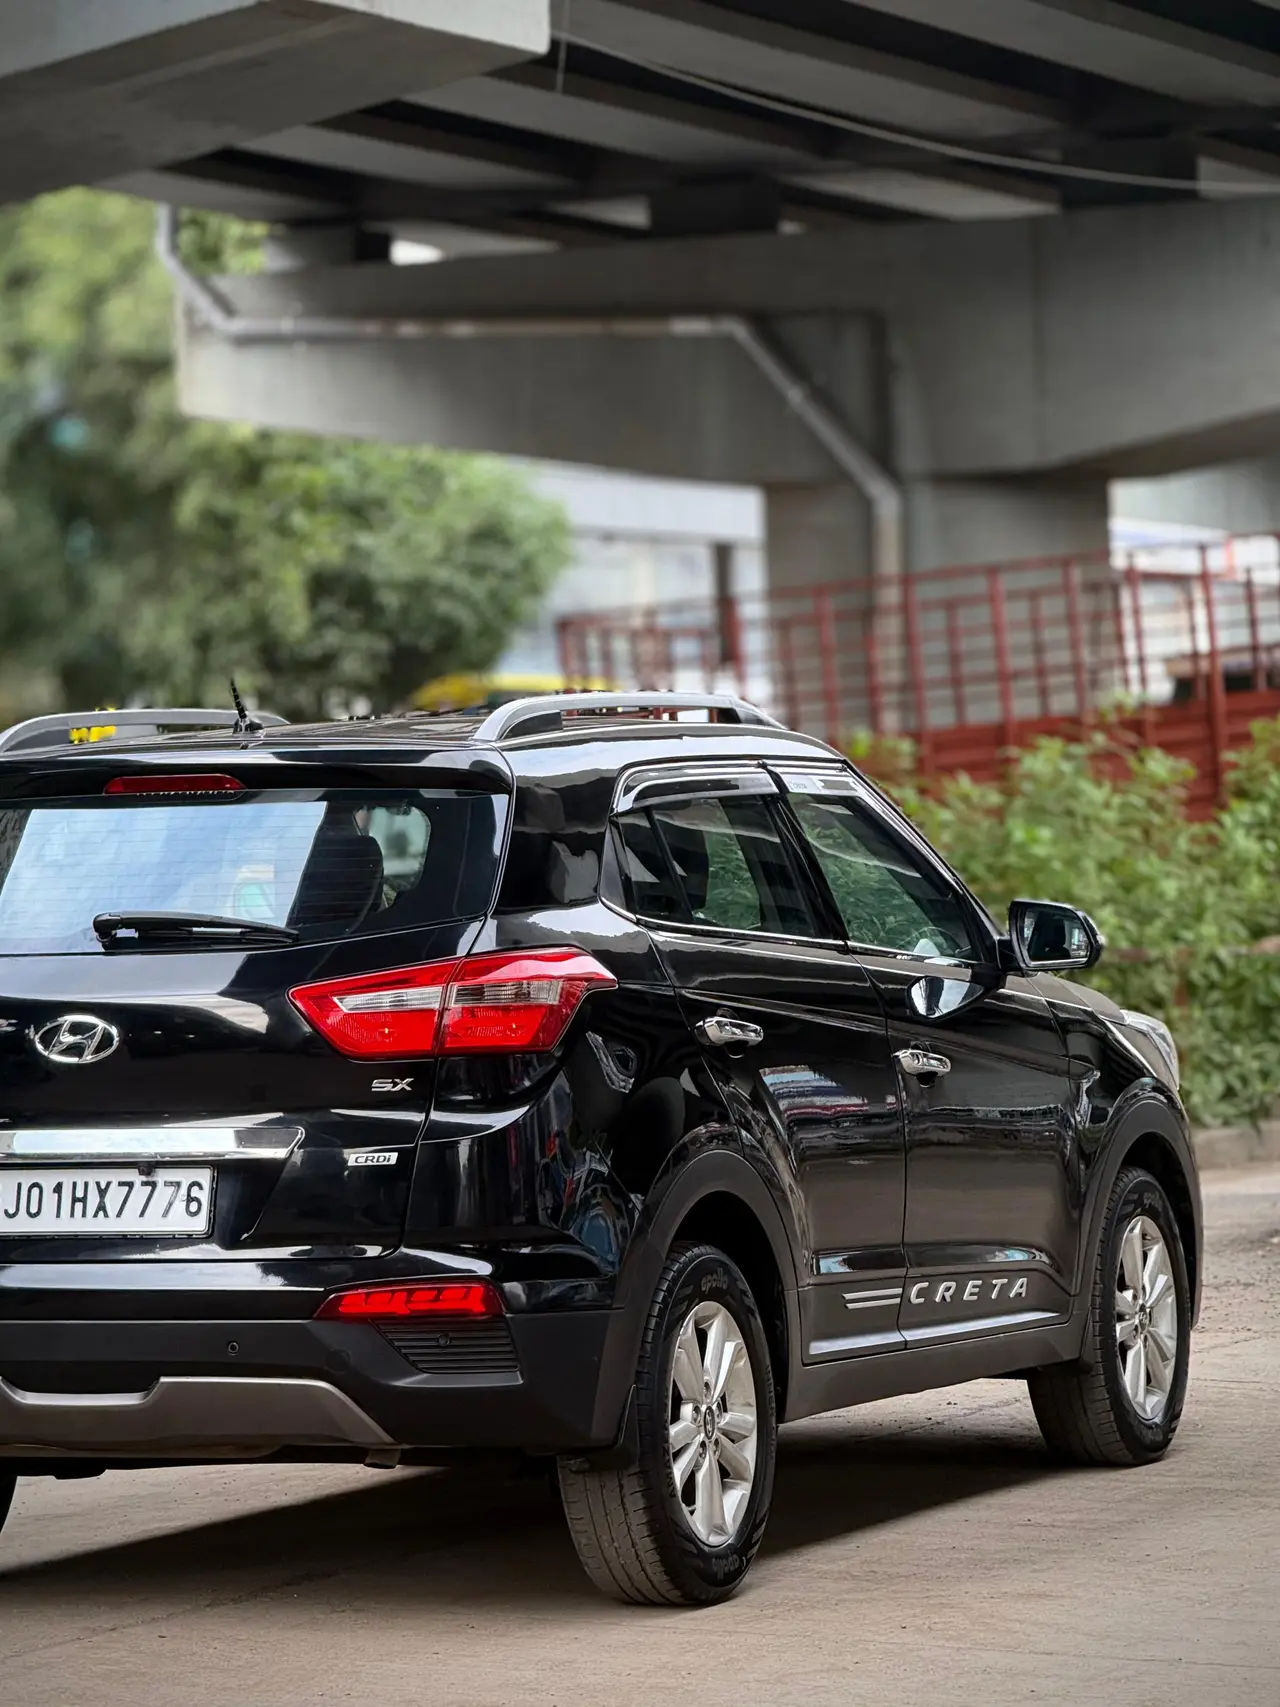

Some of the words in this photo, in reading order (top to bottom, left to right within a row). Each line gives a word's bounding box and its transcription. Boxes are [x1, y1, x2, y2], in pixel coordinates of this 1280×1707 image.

[371, 1078, 414, 1092] SX
[354, 1154, 391, 1165] CRDi
[3, 1180, 204, 1219] J01HX7776
[909, 1277, 1028, 1304] CRETA
